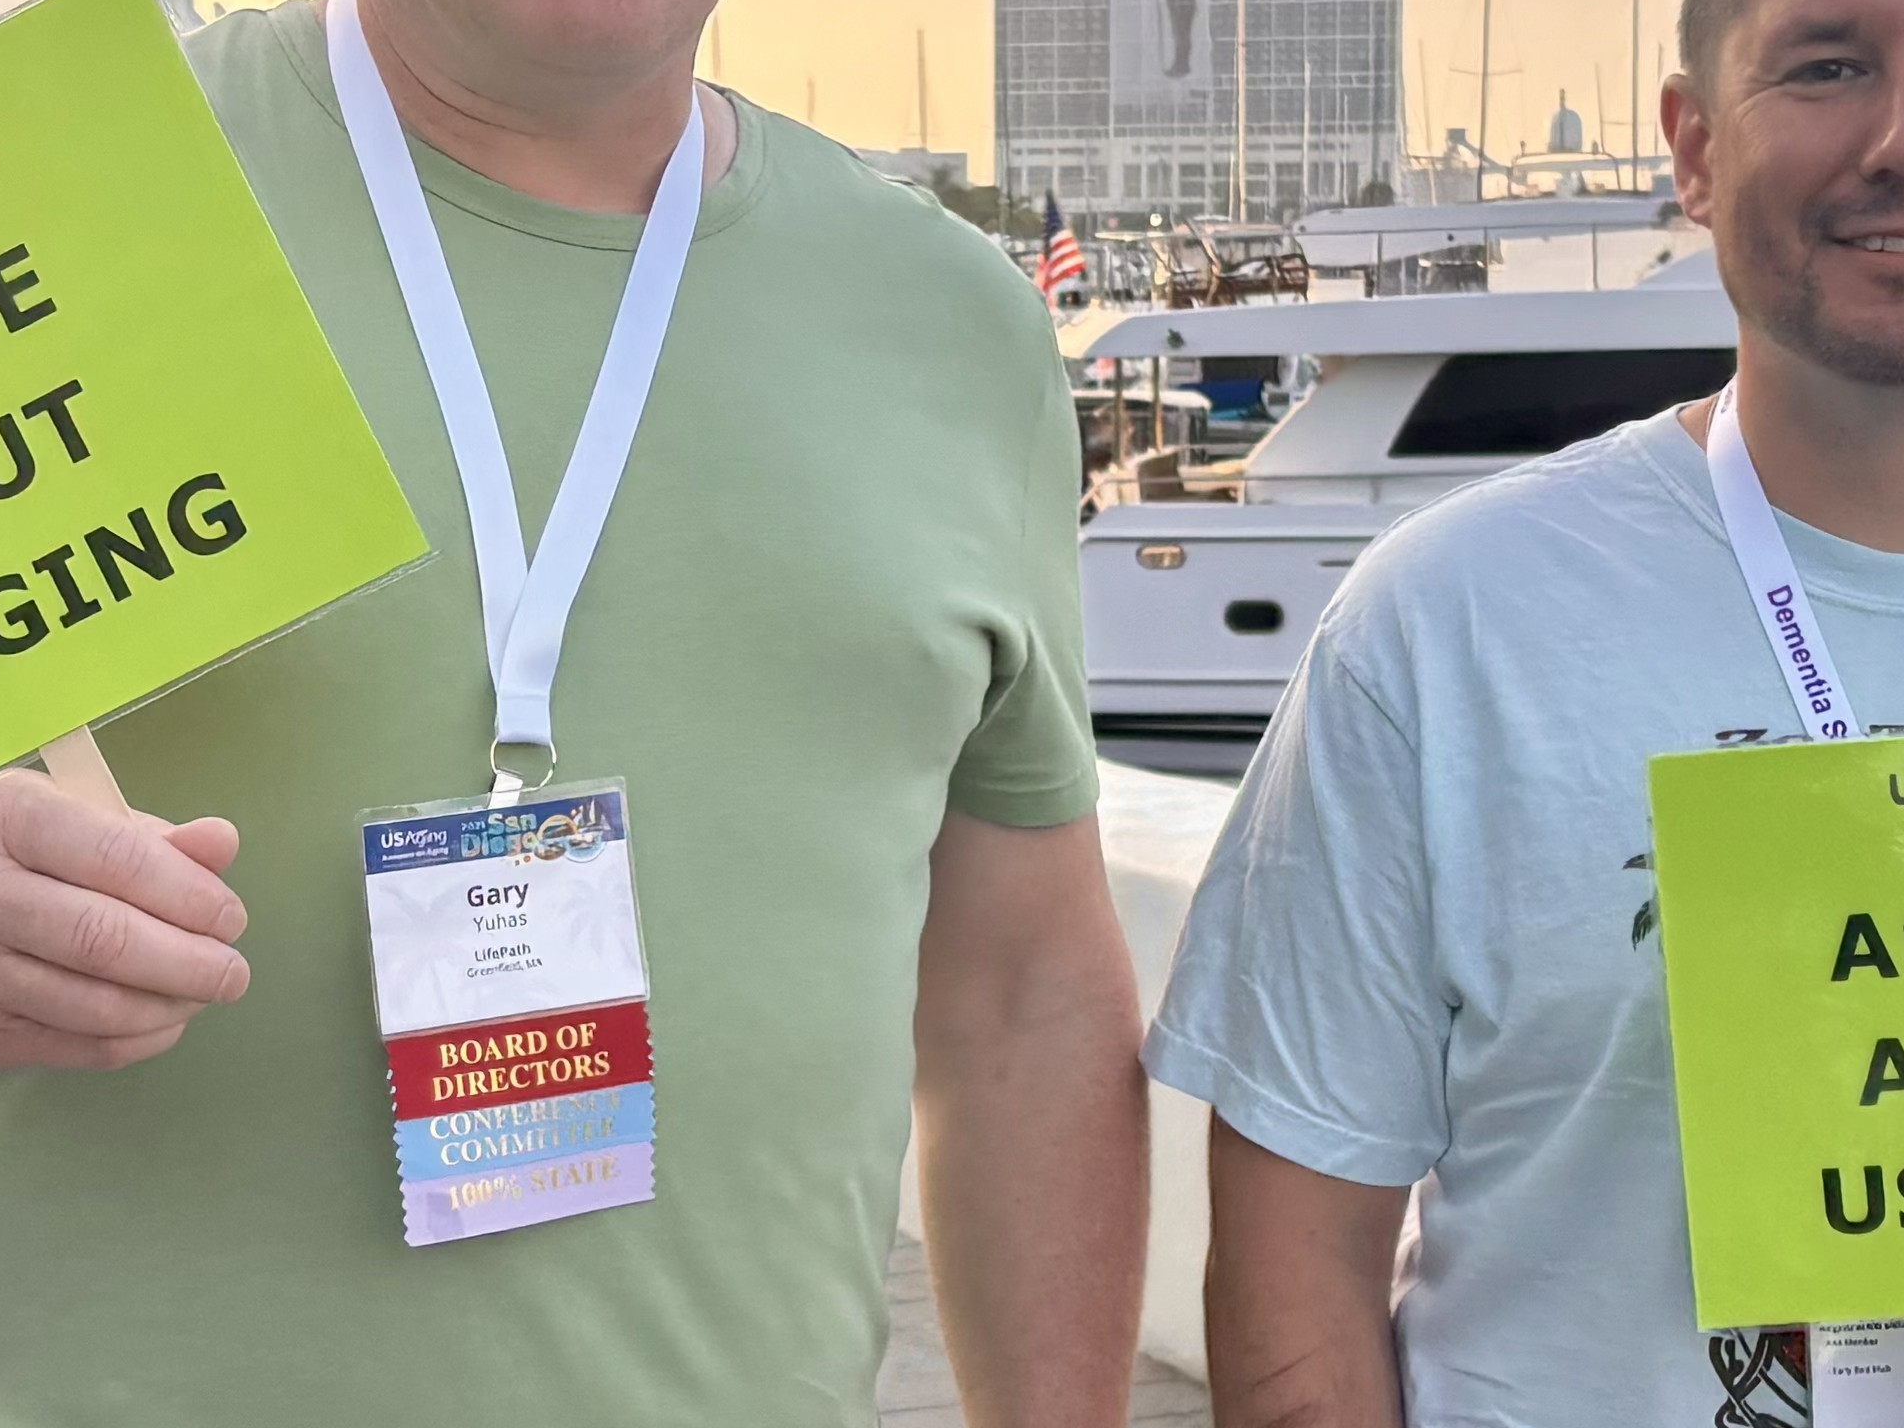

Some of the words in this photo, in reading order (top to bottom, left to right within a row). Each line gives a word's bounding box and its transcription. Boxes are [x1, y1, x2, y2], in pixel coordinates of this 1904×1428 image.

[1767, 584, 1831, 715] Dementia
[487, 812, 537, 835] San
[467, 883, 529, 908] Gary
[473, 913, 527, 932] Yuhas
[439, 1030, 548, 1069] BOARD
[555, 1021, 598, 1051] OF
[432, 1051, 611, 1102] DIRECTORS
[440, 1117, 616, 1167] COMMITTEE
[449, 1173, 523, 1211] 100%
